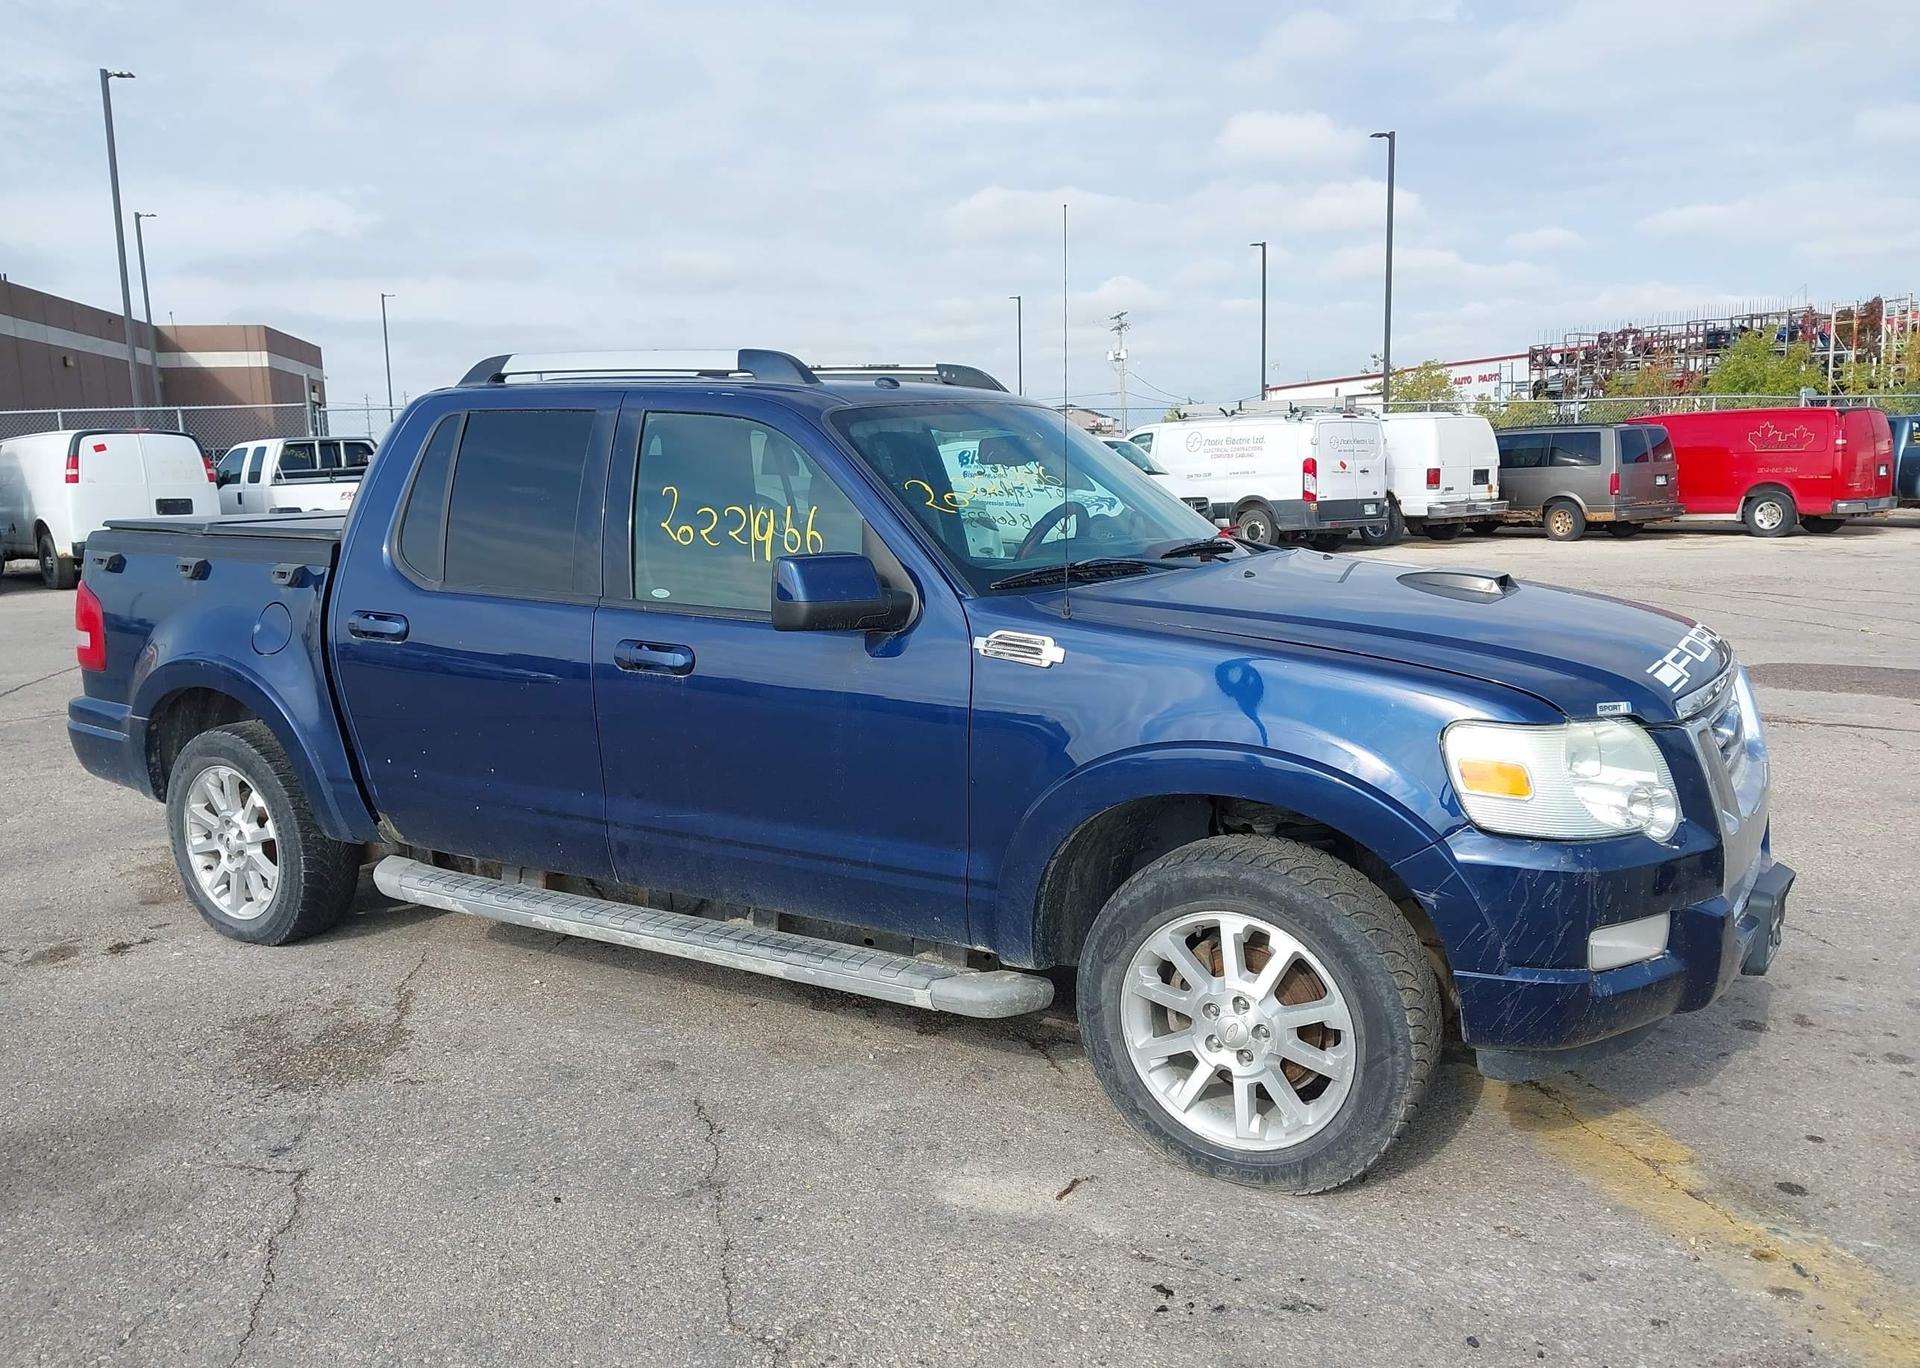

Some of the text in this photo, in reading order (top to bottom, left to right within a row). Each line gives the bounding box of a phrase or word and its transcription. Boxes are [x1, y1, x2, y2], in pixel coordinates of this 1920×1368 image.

[1453, 372, 1502, 385] AUTO PARTS
[661, 486, 823, 562] 20221966
[1598, 704, 1622, 712] SPORT
